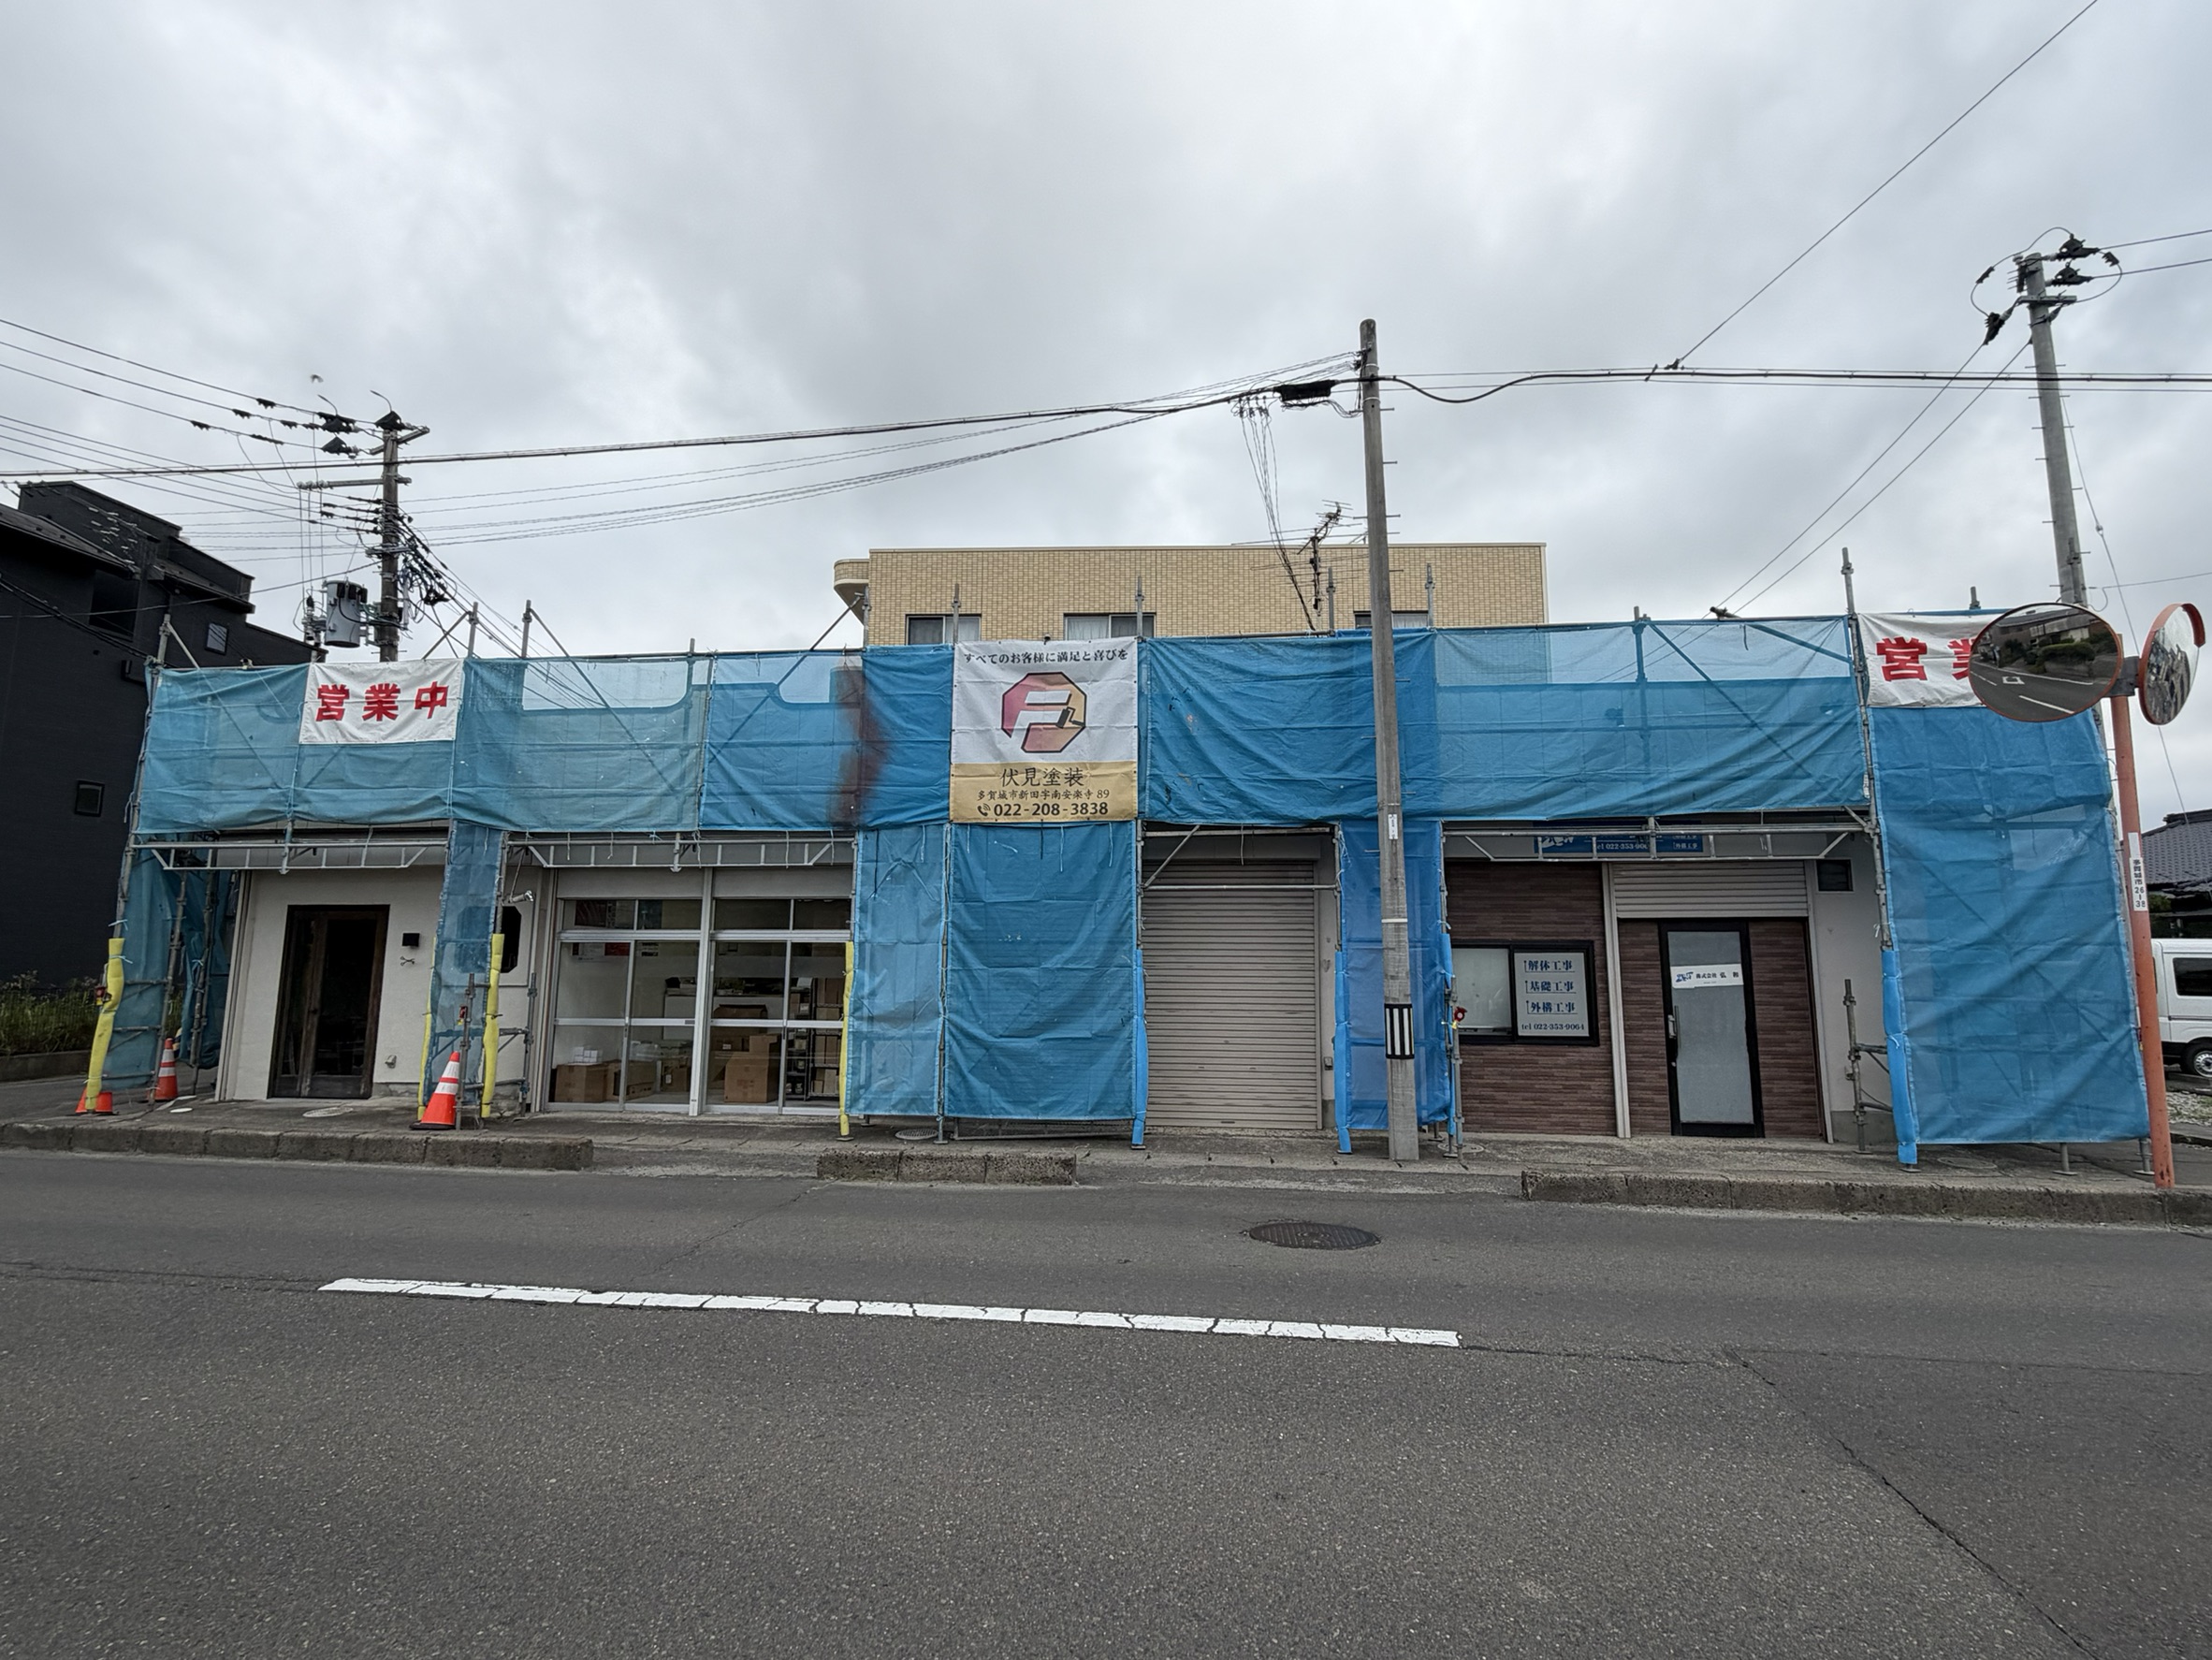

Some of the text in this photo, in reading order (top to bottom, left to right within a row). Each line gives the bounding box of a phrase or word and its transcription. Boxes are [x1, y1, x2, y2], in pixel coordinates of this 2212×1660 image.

[964, 648, 1128, 664] すべてのお客様に満足と喜びを
[315, 681, 449, 721] 営業中
[1000, 767, 1084, 788] 伏見塗装
[994, 801, 1109, 817] 022-208-3838
[1528, 960, 1573, 970] 解体工事
[1530, 981, 1574, 992] 基礎工事
[1531, 1001, 1575, 1012] 外構工事
